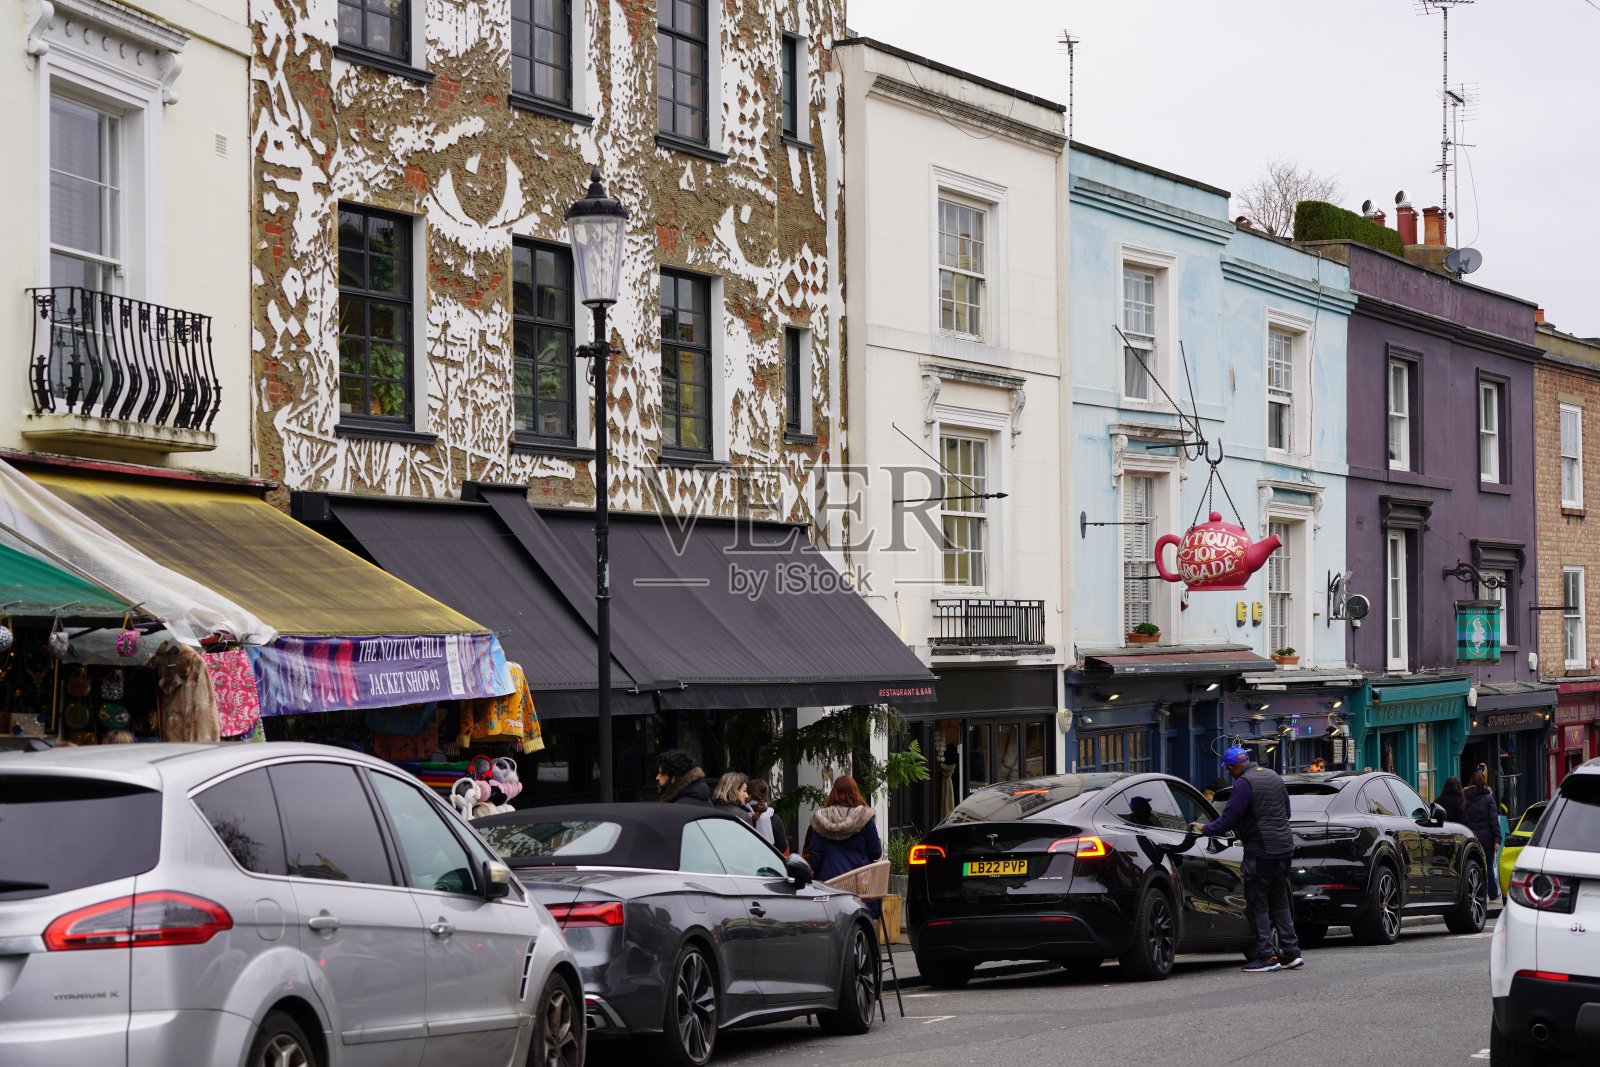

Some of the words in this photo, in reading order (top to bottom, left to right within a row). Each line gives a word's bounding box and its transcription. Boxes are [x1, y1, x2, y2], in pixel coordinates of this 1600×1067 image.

[1194, 547, 1217, 562] 101
[359, 640, 377, 662] THE
[379, 637, 420, 661] NOTTING
[421, 637, 443, 659] HILL
[369, 671, 405, 695] JACKET
[406, 669, 430, 692] SHOP
[431, 669, 441, 691] 93
[879, 688, 915, 696] RESTAURANT
[920, 687, 932, 695] BAR
[1377, 704, 1427, 720] HIGHLAND
[970, 862, 1000, 874] LB22
[1002, 861, 1026, 873] PVP
[53, 991, 107, 1000] TITANIUM
[109, 990, 119, 999] X
